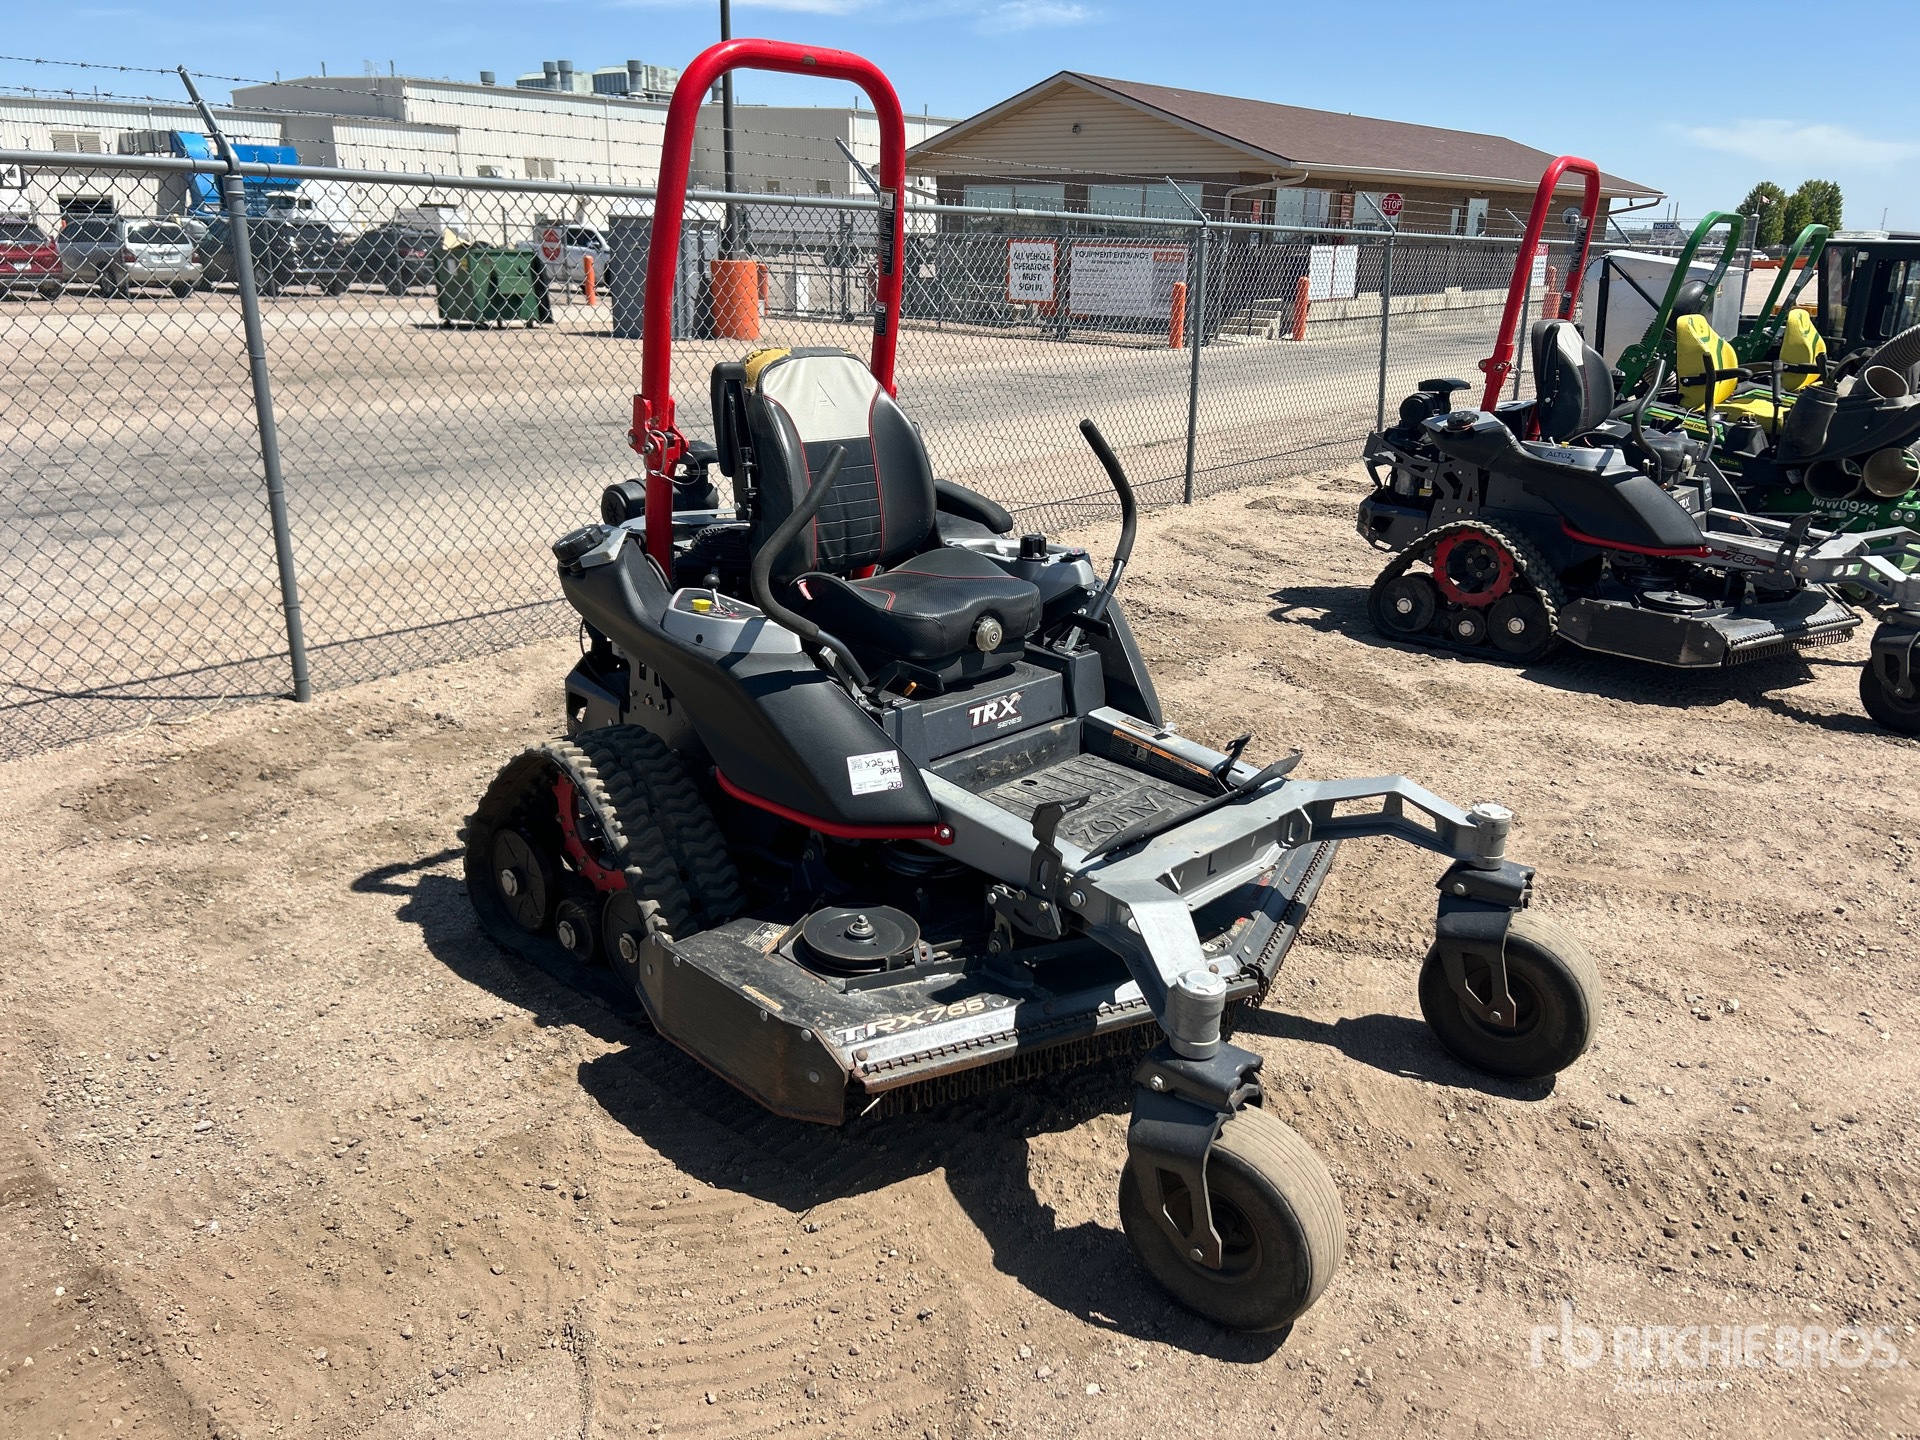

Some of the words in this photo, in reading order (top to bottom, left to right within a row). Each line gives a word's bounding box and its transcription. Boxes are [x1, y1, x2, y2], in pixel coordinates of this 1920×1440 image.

[1382, 200, 1402, 210] STOP
[1025, 252, 1051, 261] VEHICLE
[1114, 251, 1149, 260] ENTRANCE
[1013, 262, 1051, 271] OPERATORS
[1022, 272, 1041, 281] MUST
[1545, 450, 1573, 460] ALTOZ
[969, 691, 1022, 727] TRX
[997, 715, 1022, 729] SERIES
